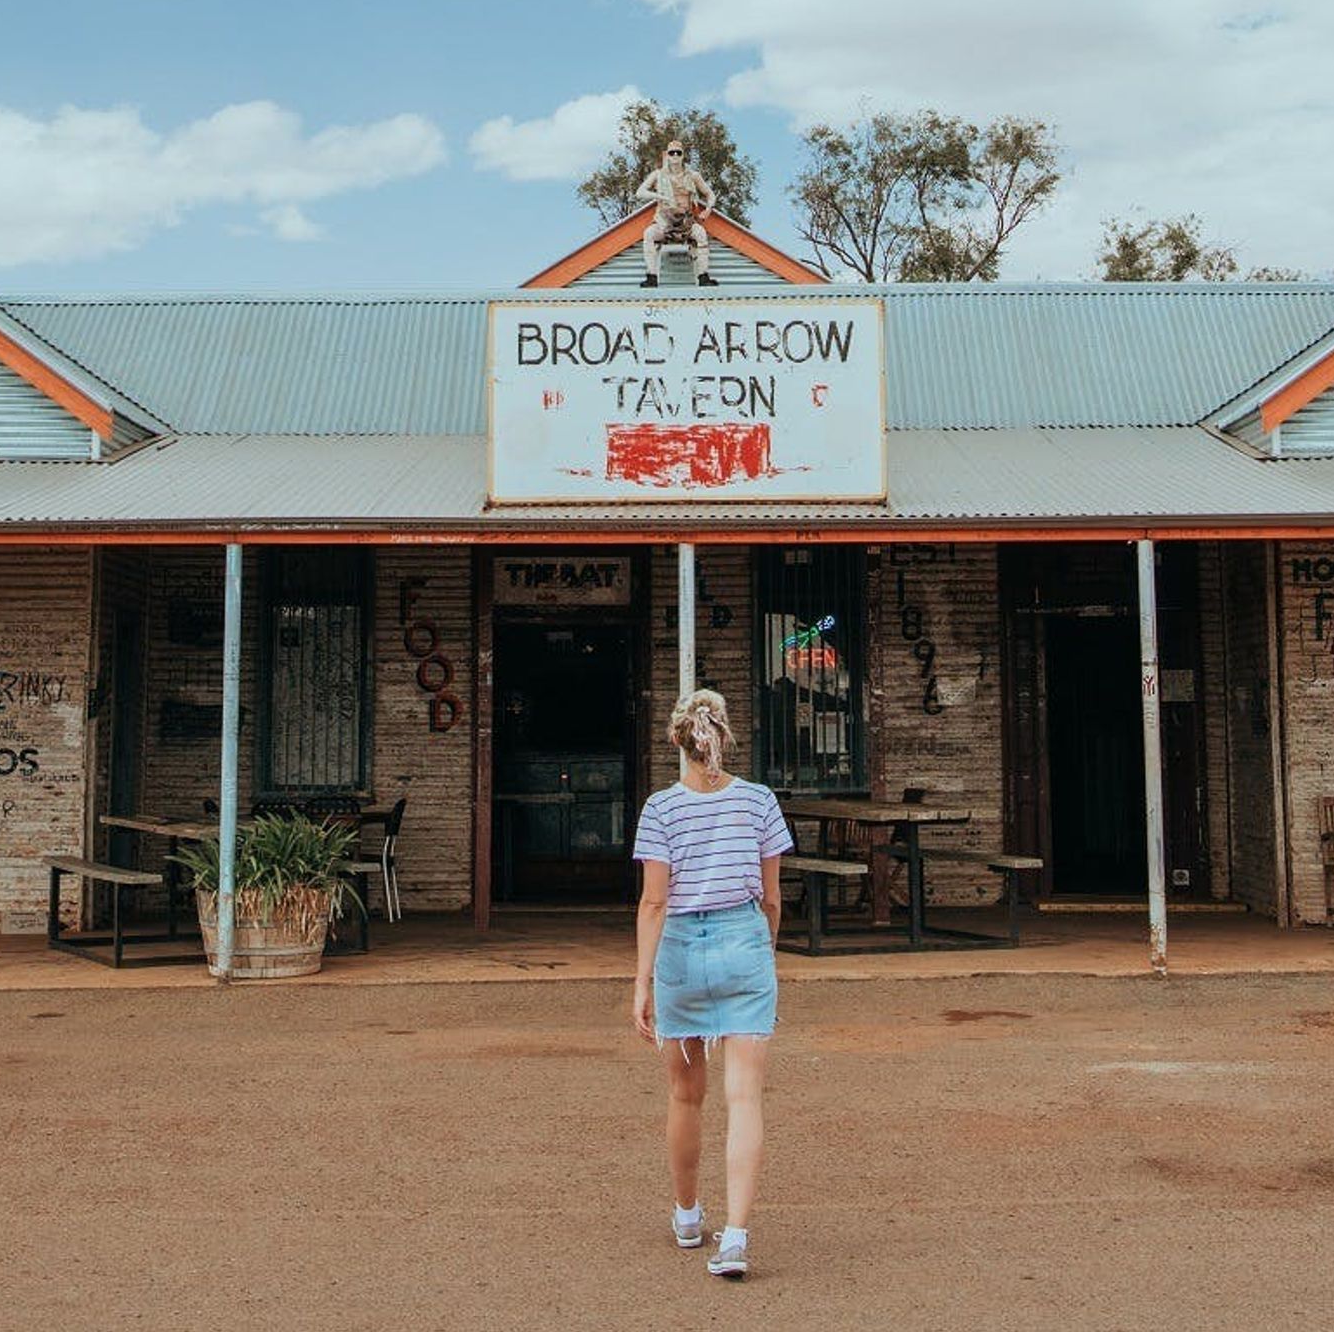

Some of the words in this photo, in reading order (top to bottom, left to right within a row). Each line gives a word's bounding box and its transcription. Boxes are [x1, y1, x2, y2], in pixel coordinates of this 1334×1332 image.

[517, 320, 676, 366] BROAD
[693, 319, 855, 365] ARROW
[601, 374, 778, 419] TAVERN
[398, 579, 464, 734] FOOD
